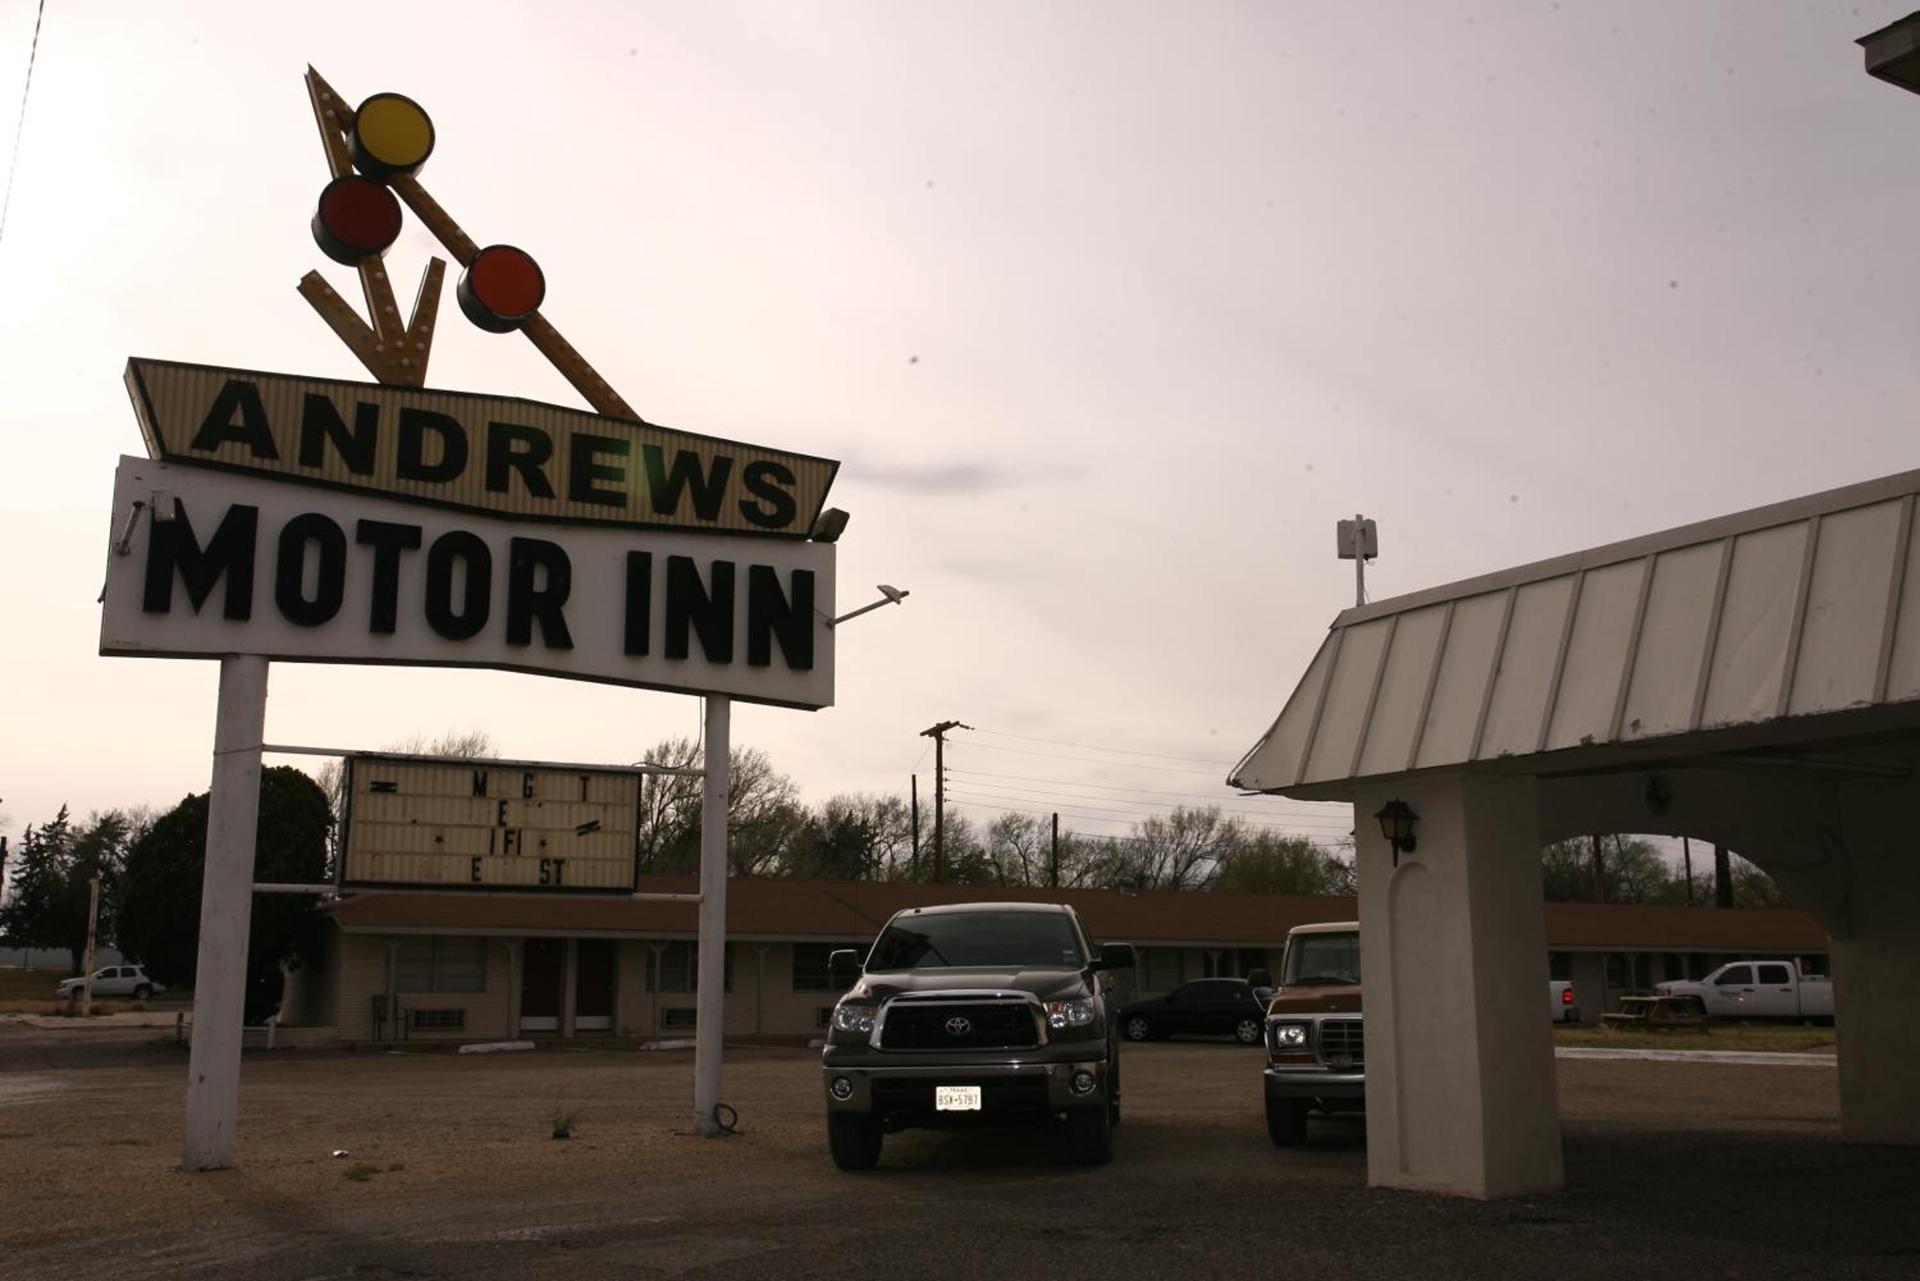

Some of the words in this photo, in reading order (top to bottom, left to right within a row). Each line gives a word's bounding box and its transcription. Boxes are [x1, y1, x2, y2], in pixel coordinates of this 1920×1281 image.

[190, 379, 798, 529] ANDREWS
[142, 496, 573, 650] MOTOR
[624, 550, 814, 670] INN
[497, 800, 508, 827] E
[471, 857, 482, 882] E
[540, 859, 565, 885] ST
